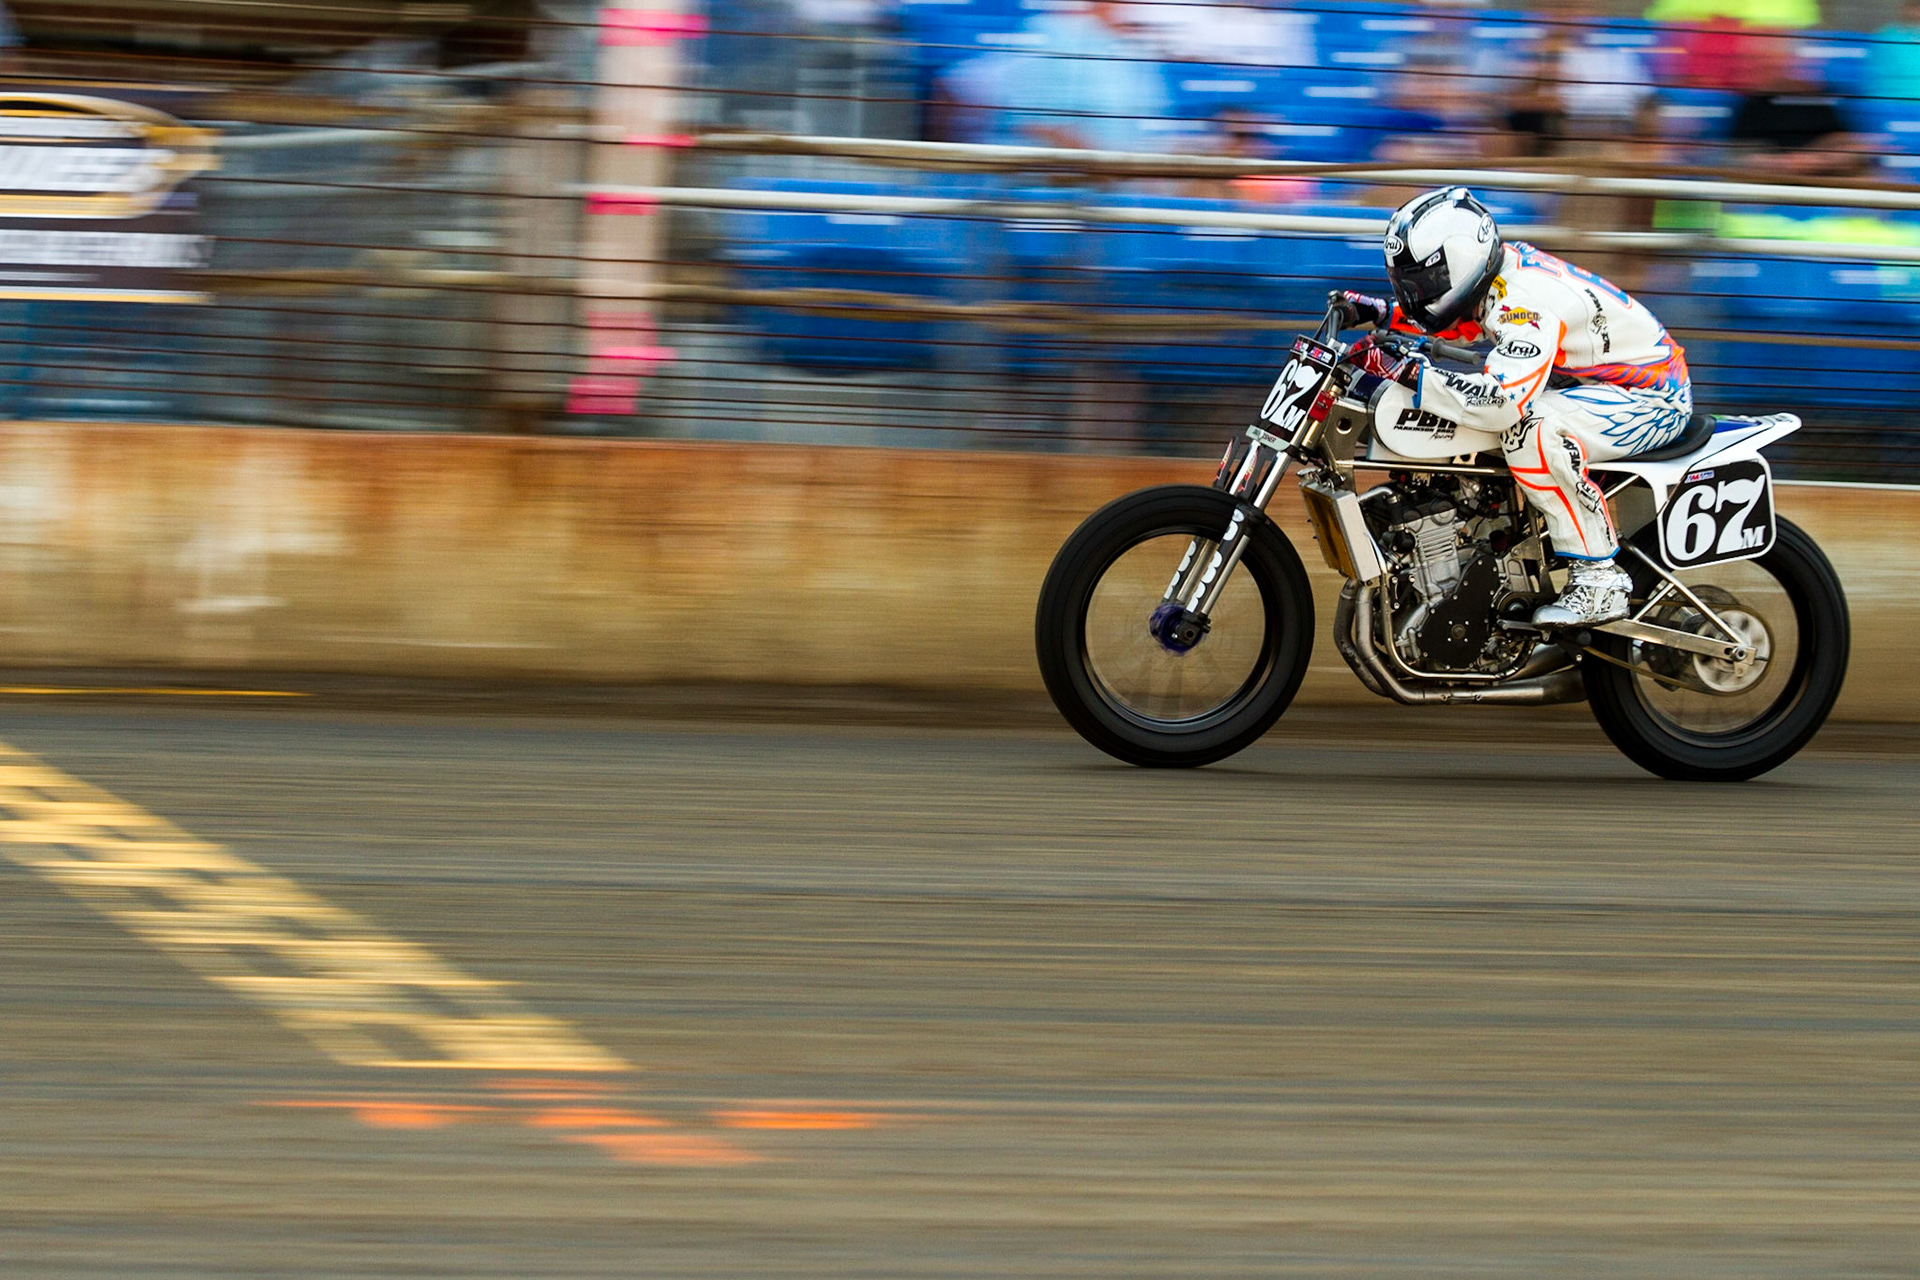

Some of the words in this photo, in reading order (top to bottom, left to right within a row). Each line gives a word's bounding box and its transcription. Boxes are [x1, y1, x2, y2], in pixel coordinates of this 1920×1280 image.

[1499, 311, 1539, 324] SUNOCO
[1500, 340, 1536, 356] Arai
[1445, 375, 1500, 398] WALL
